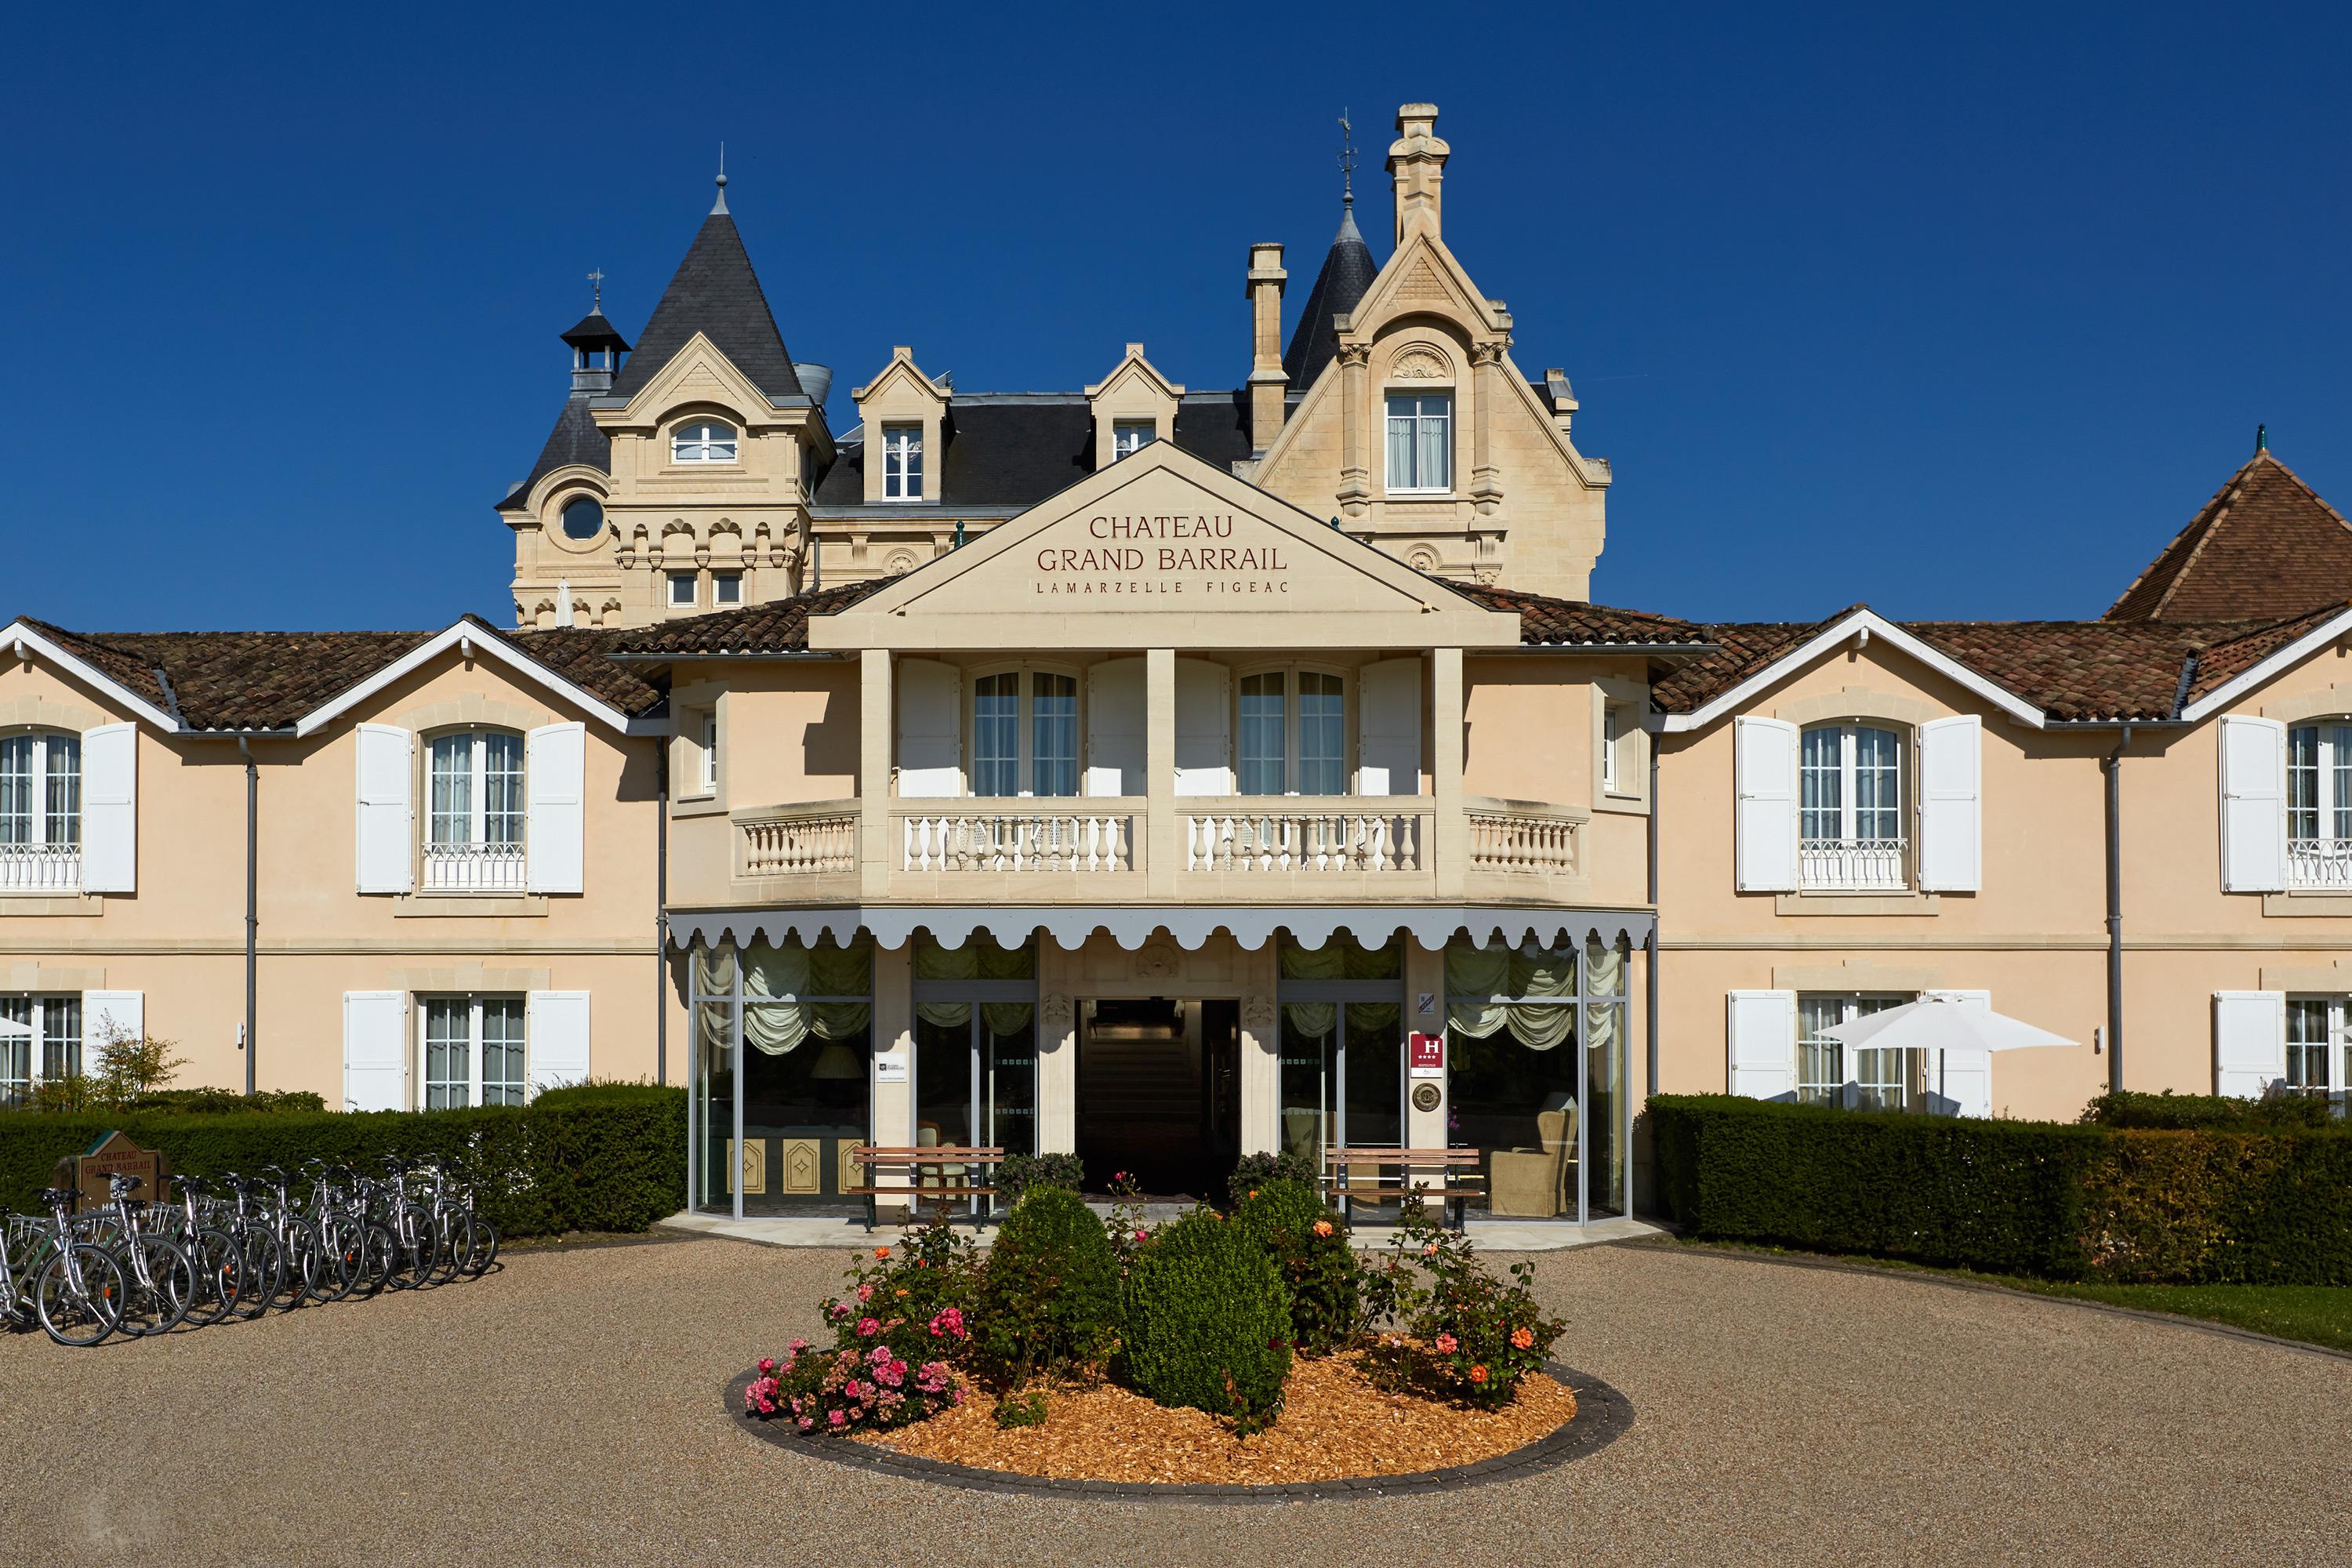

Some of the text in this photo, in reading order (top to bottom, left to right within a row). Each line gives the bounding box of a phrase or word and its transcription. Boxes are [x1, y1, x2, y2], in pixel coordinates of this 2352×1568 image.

[1090, 516, 1232, 538] CHATEAU
[1038, 549, 1287, 571] GRAND BARRAIL
[1038, 583, 1287, 593] LAMARZELLE FIGEAC
[1425, 1040, 1439, 1054] H
[101, 1151, 136, 1161] CHATEAU
[86, 1164, 113, 1174] GRAND
[117, 1161, 151, 1171] BARRAIL
